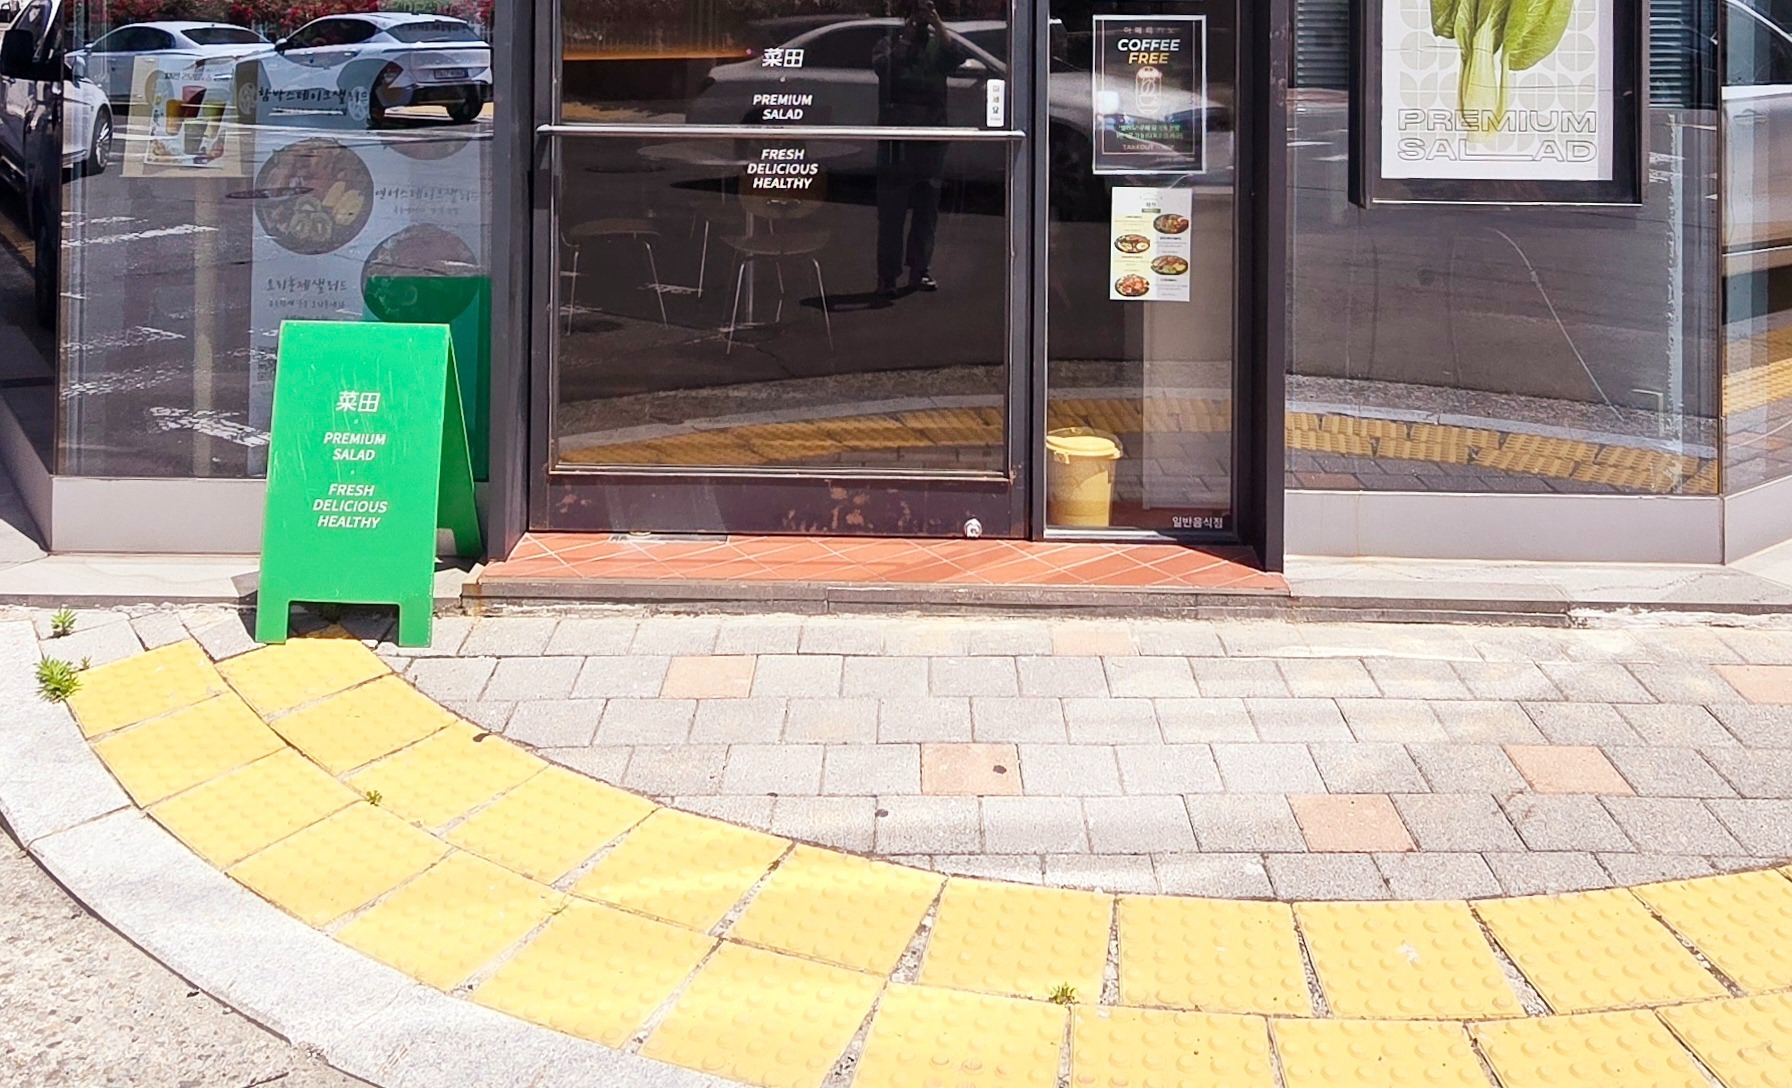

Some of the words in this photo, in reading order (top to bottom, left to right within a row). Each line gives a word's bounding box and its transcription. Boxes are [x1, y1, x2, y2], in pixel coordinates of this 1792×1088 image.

[1117, 38, 1181, 51] COFFEE
[762, 48, 804, 67] 菜田
[1128, 52, 1170, 64] FREE
[753, 94, 813, 106] PREMIUM
[762, 108, 804, 120] SALAD
[1398, 109, 1598, 134] PREMIUM
[761, 148, 805, 160] FRESH
[747, 163, 819, 175] DELICIOUS
[753, 177, 813, 189] HEALTHY
[336, 391, 380, 413] 菜田
[323, 432, 386, 446] PREMIUM
[332, 448, 376, 461] SALAD
[328, 483, 375, 496] FRESH
[312, 500, 388, 513] DELICIOUS
[317, 515, 381, 529] HEALTHY
[1172, 516, 1223, 529] 일반음식점
